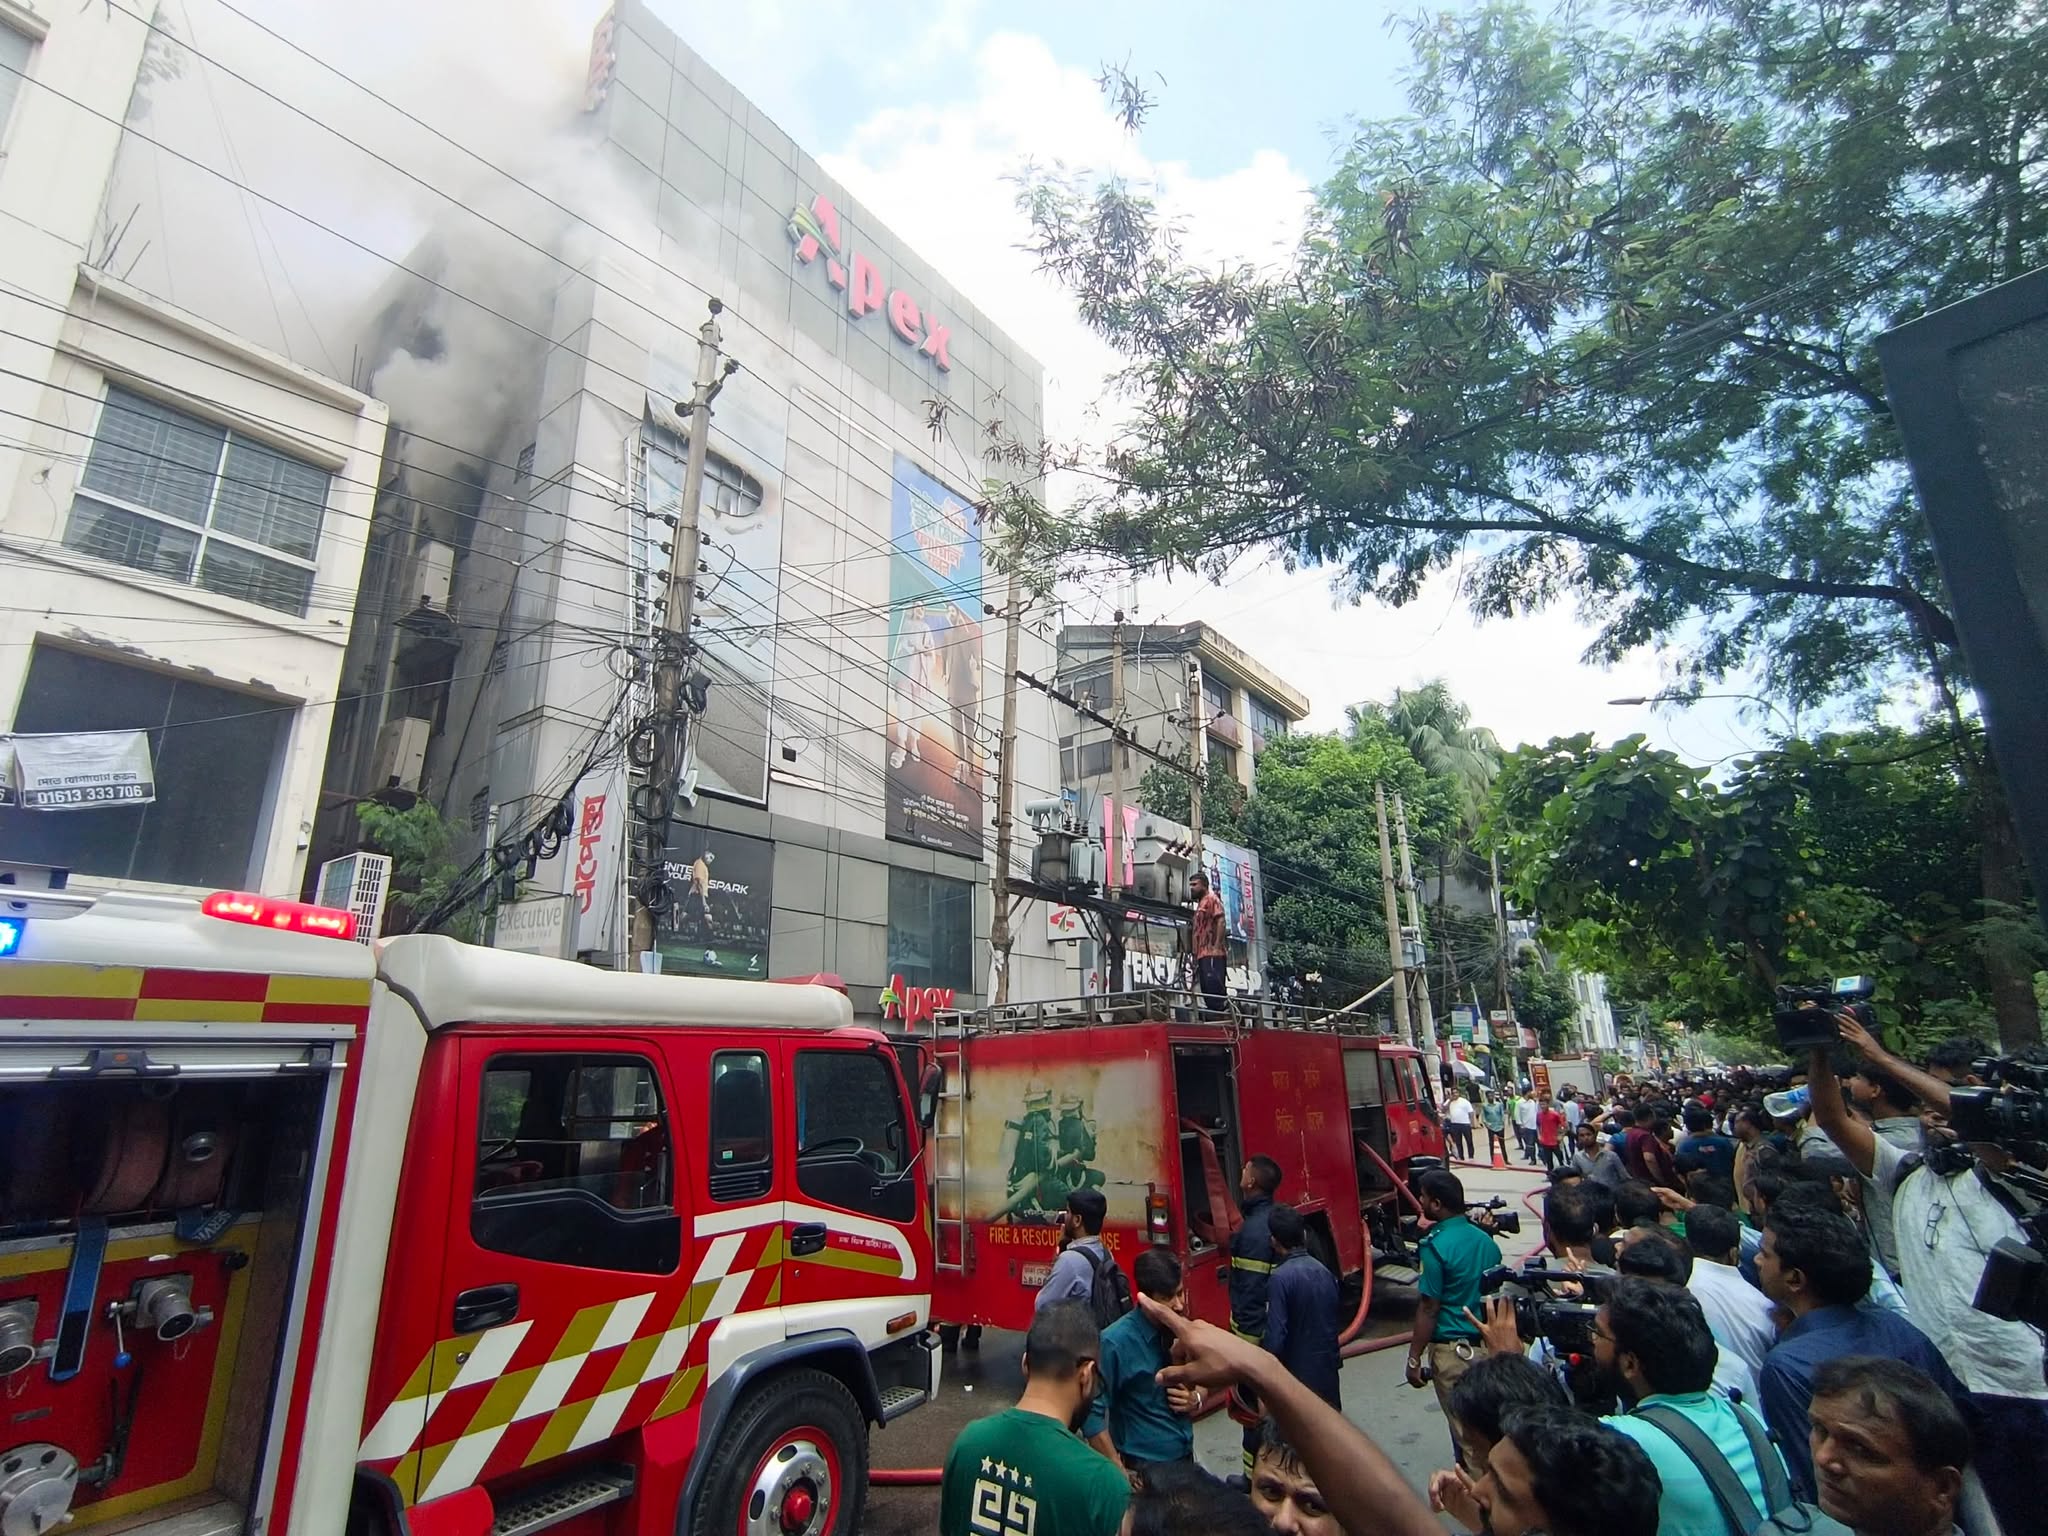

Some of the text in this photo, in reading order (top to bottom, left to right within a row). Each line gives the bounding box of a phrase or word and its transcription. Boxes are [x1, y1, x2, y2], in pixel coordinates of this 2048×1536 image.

[787, 193, 951, 373] Apex
[37, 785, 143, 804] 01613 333 706
[707, 879, 749, 895] SPARK
[499, 906, 561, 931] executive
[879, 973, 955, 1032] Apex
[989, 1226, 1010, 1244] FIRE
[1012, 1227, 1020, 1244] &
